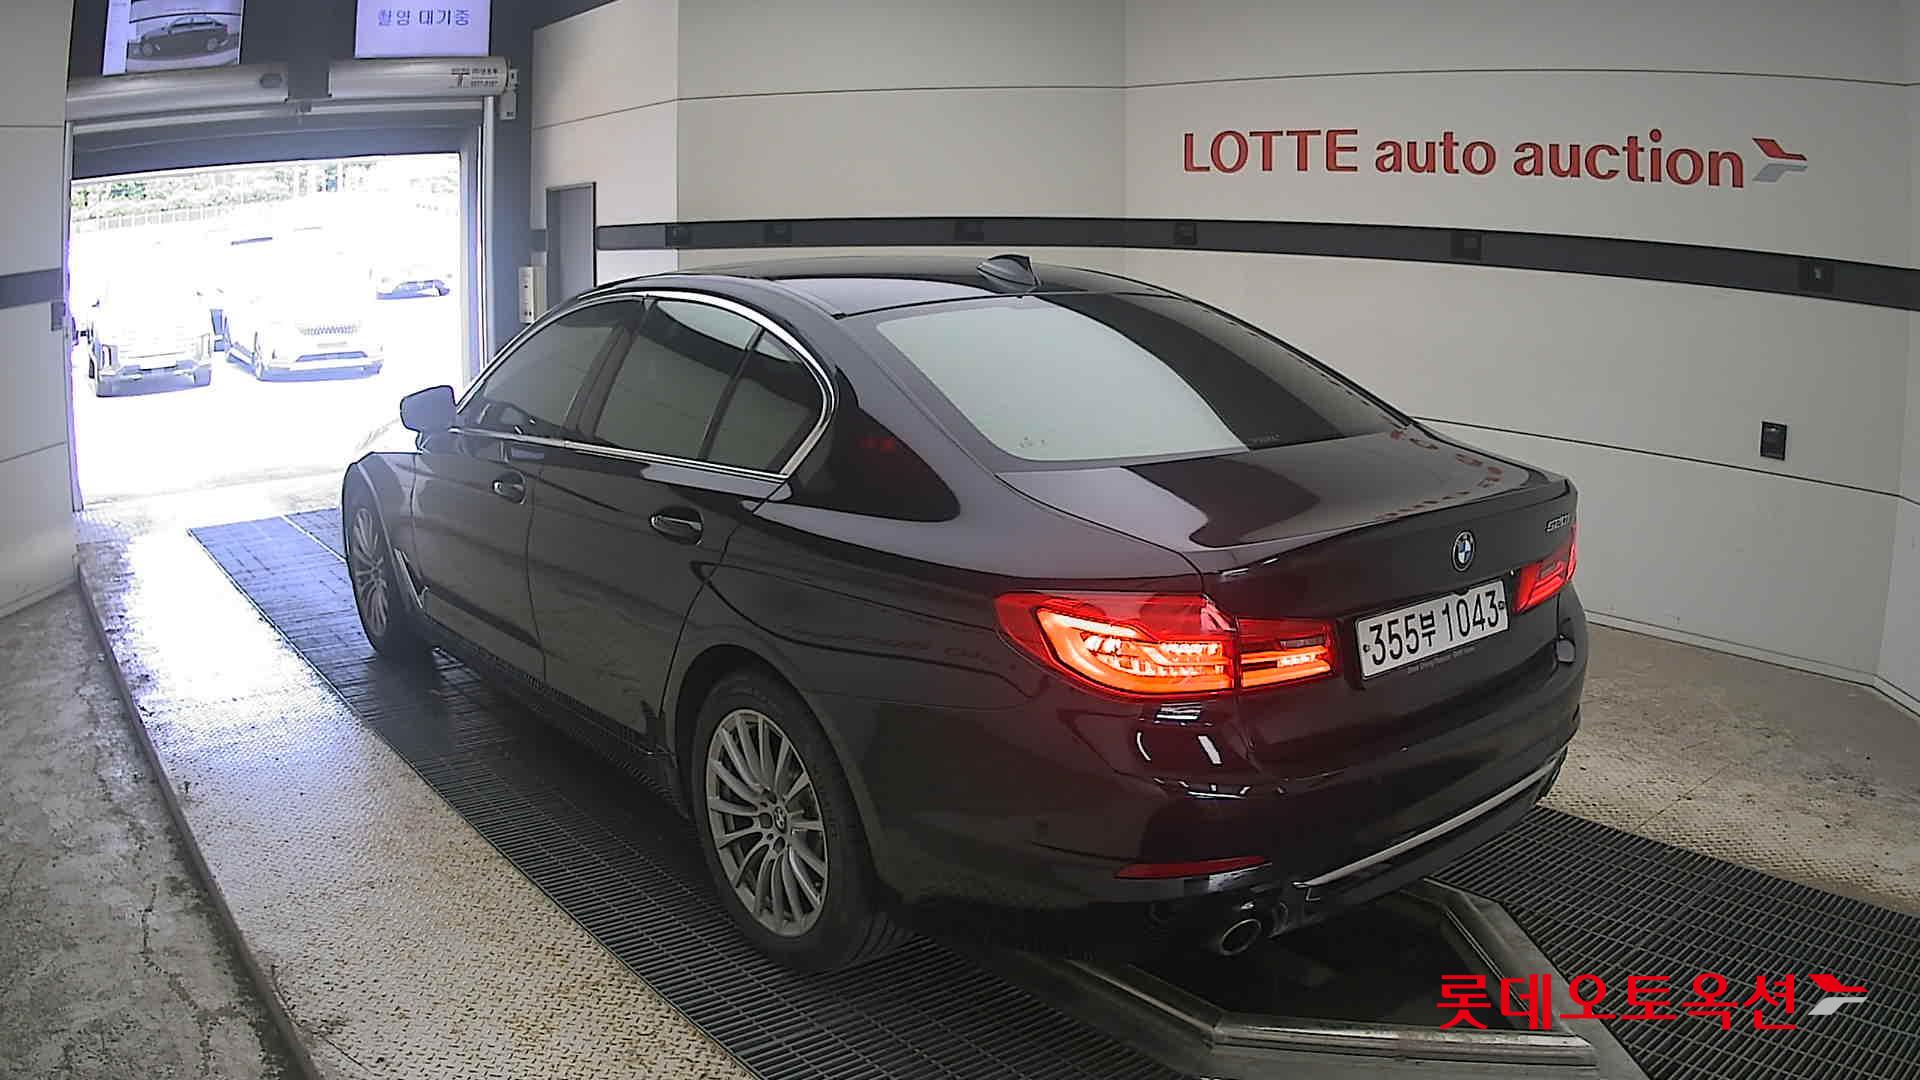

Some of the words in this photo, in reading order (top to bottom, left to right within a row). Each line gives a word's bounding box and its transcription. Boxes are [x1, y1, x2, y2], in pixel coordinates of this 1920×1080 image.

[419, 8, 470, 26] 대기중
[1183, 128, 1359, 173] LOTTE
[1375, 130, 1497, 176] auto
[1513, 127, 1745, 189] auction
[1368, 609, 1437, 667] 355부
[1442, 589, 1500, 642] 1043
